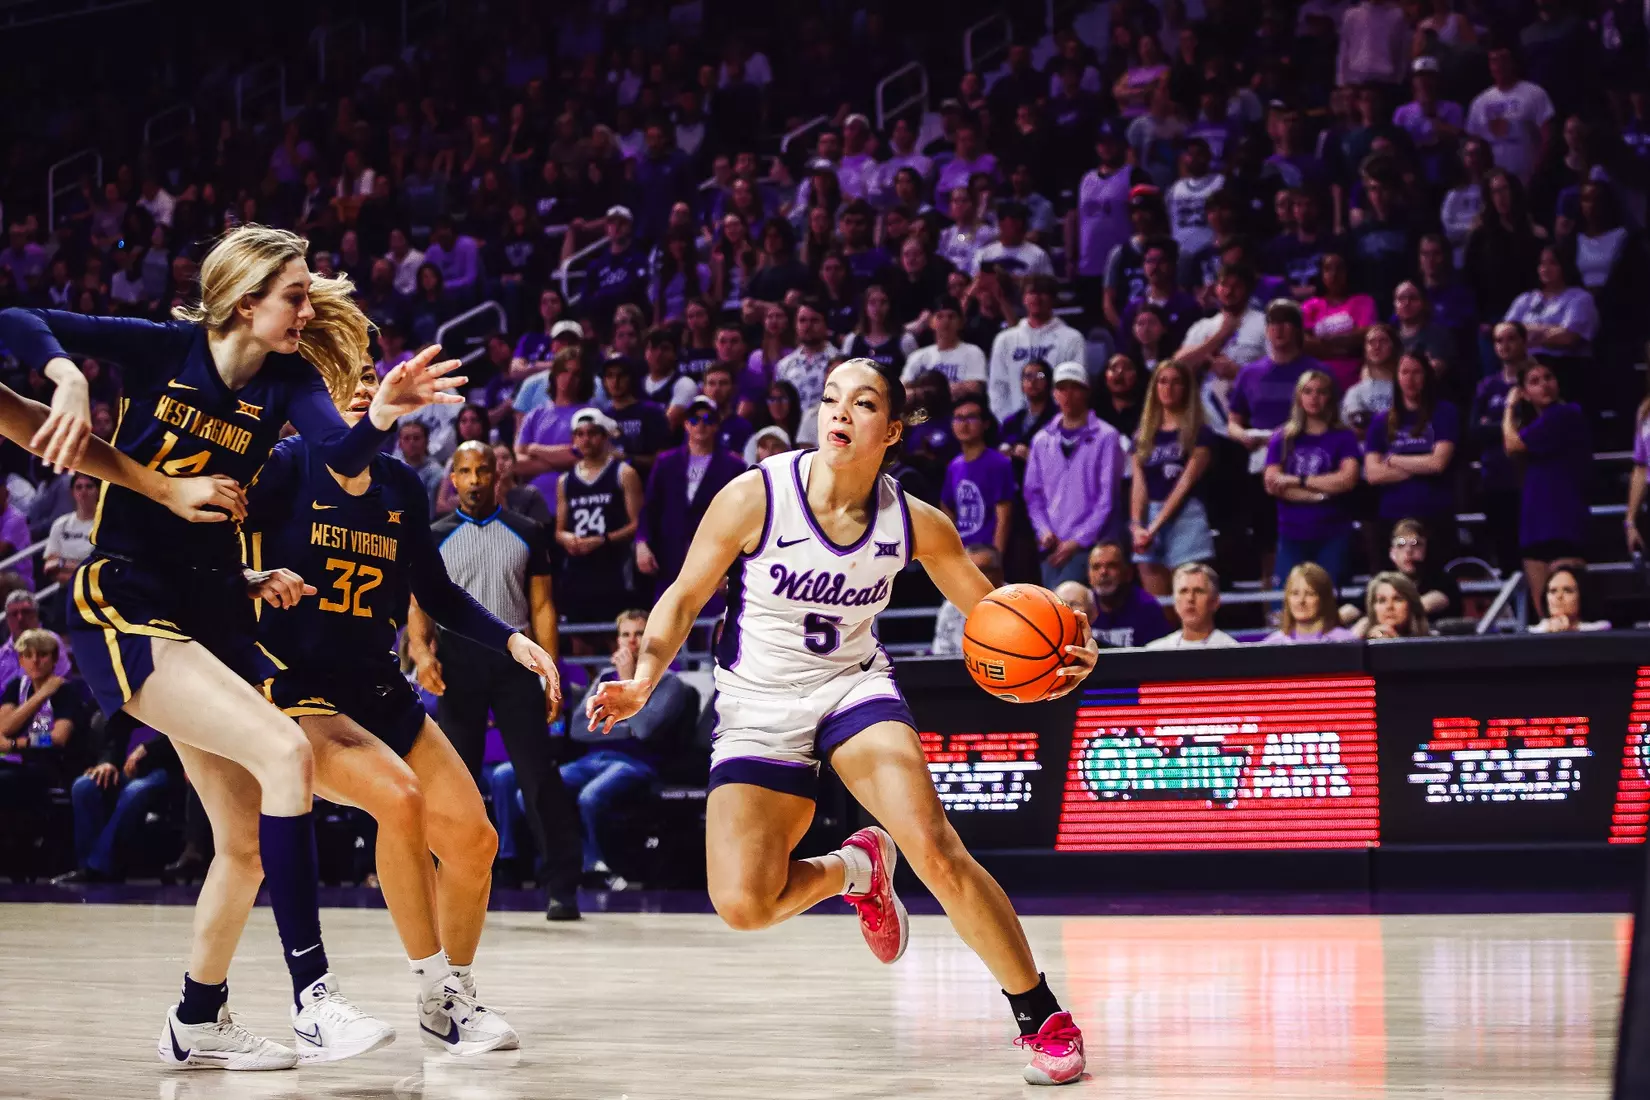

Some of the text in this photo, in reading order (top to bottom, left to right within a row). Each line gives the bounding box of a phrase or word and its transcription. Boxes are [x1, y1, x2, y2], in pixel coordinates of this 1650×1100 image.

[153, 395, 196, 430] WEST
[310, 521, 398, 562] WEST VIRGINIA
[573, 506, 606, 538] 24
[318, 557, 384, 618] 32
[769, 563, 890, 607] Wildcats
[803, 612, 843, 656] 5
